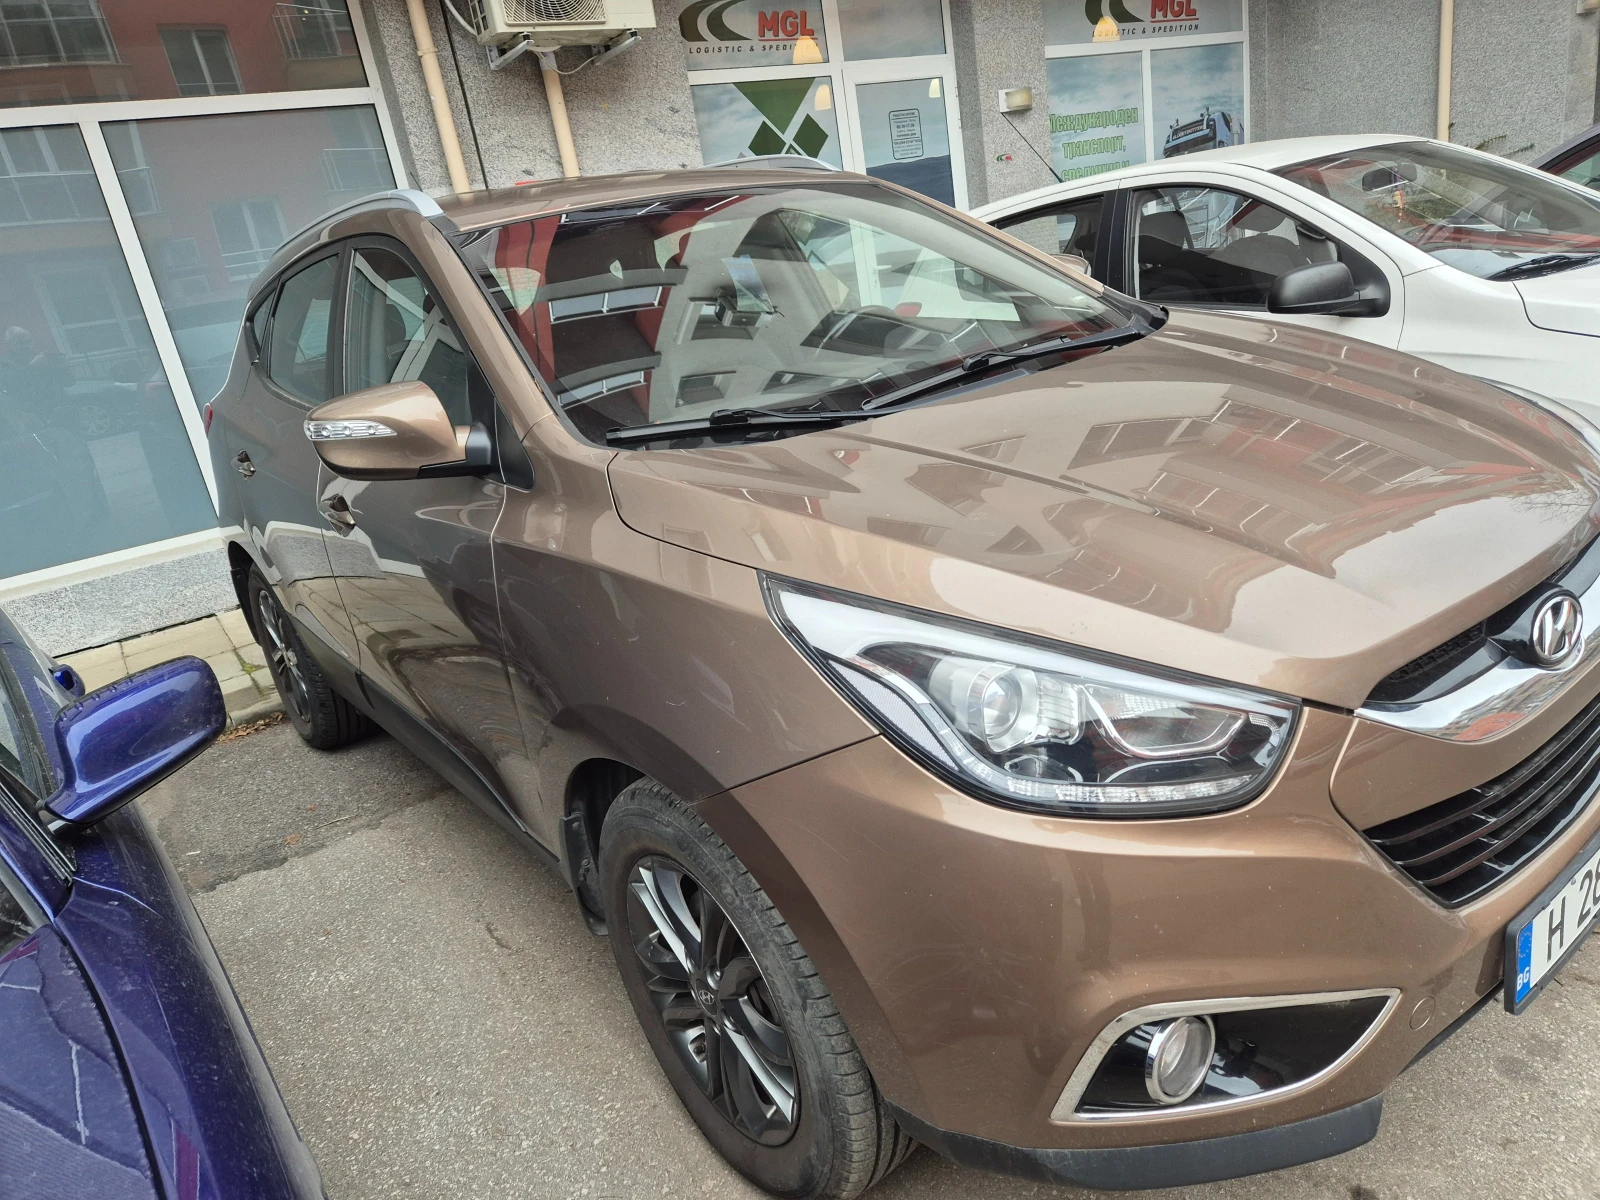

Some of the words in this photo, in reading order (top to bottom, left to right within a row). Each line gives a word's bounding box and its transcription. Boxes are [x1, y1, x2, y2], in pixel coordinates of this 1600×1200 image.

[1150, 0, 1197, 19] MGL
[758, 10, 814, 37] MGL
[1141, 26, 1146, 34] &
[1152, 23, 1199, 34] SPEDITION
[688, 45, 742, 54] LOGISTIC
[1062, 136, 1126, 159] транспорт,
[1547, 895, 1566, 963] H
[1516, 966, 1530, 991] BG
